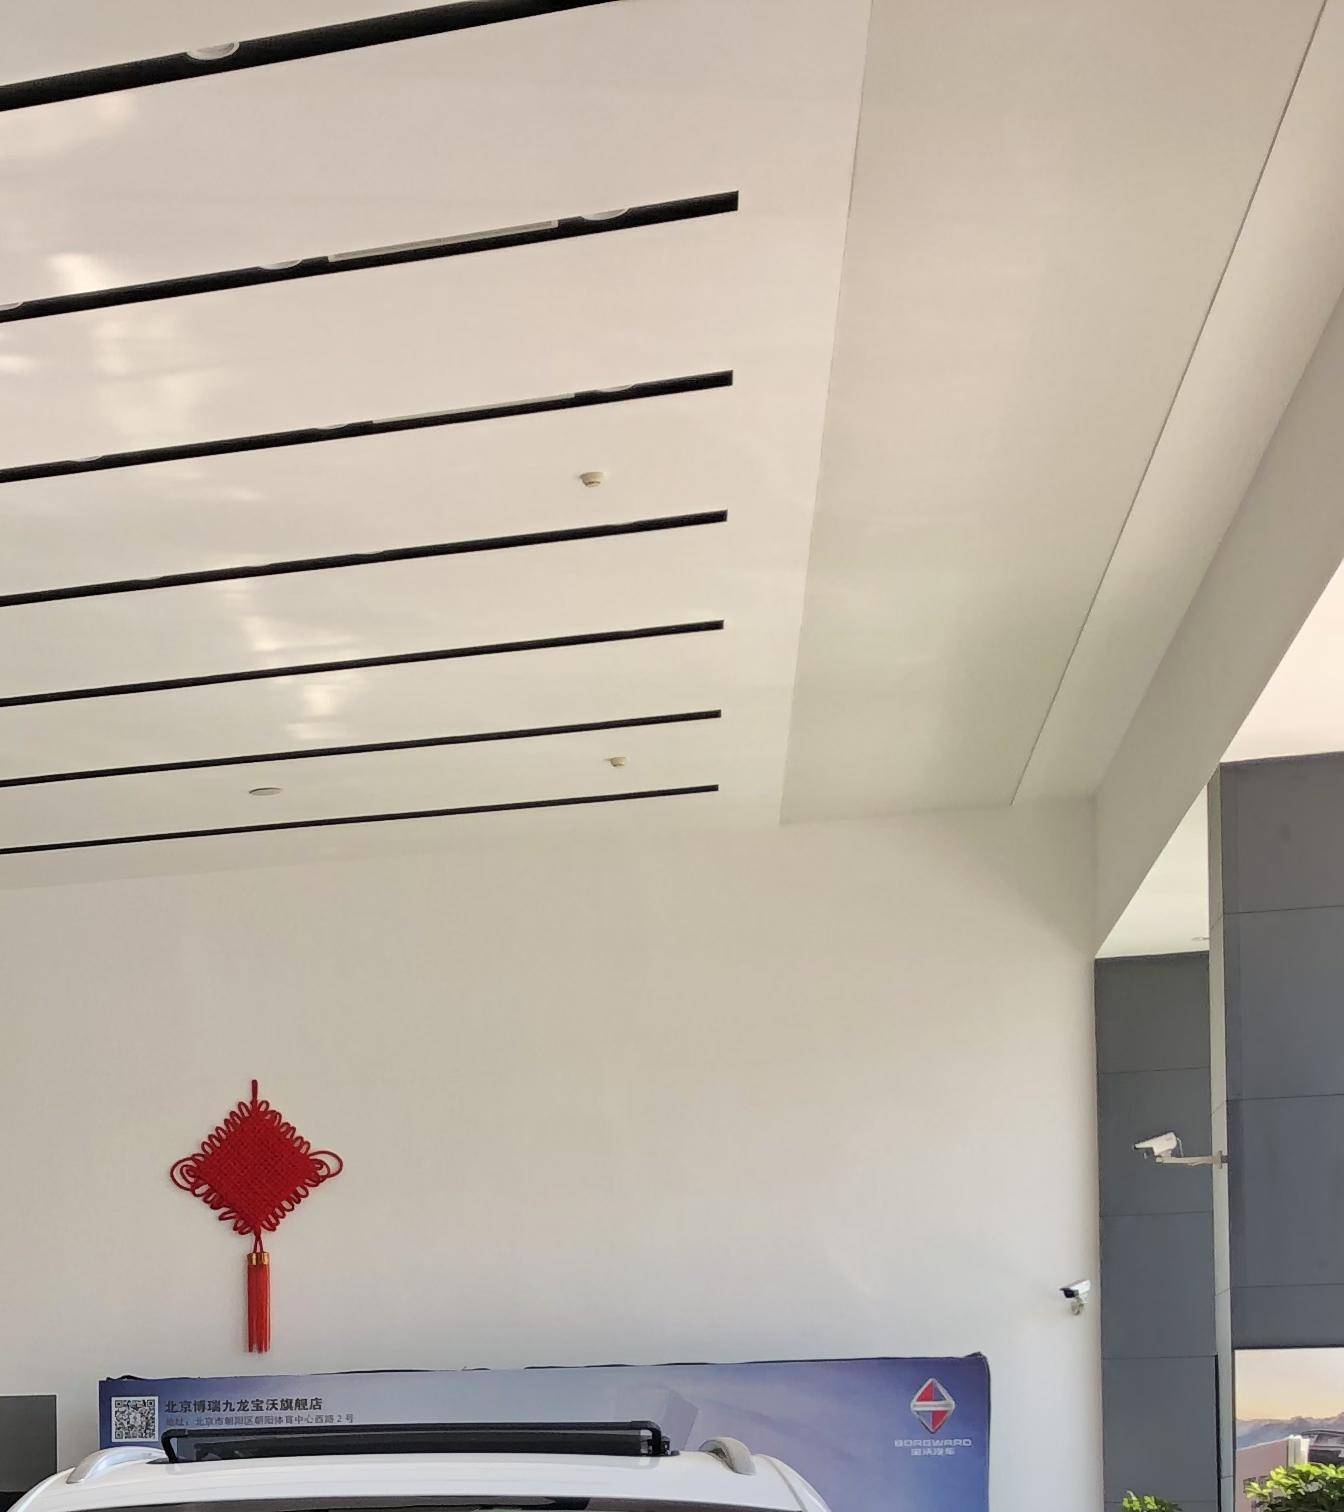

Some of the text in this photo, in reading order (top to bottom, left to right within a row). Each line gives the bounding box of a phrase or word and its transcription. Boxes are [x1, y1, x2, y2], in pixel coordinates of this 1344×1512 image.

[164, 1396, 324, 1413] 北京博瑞九龙宝沃旗舰店
[894, 1438, 973, 1447] BORGWARD
